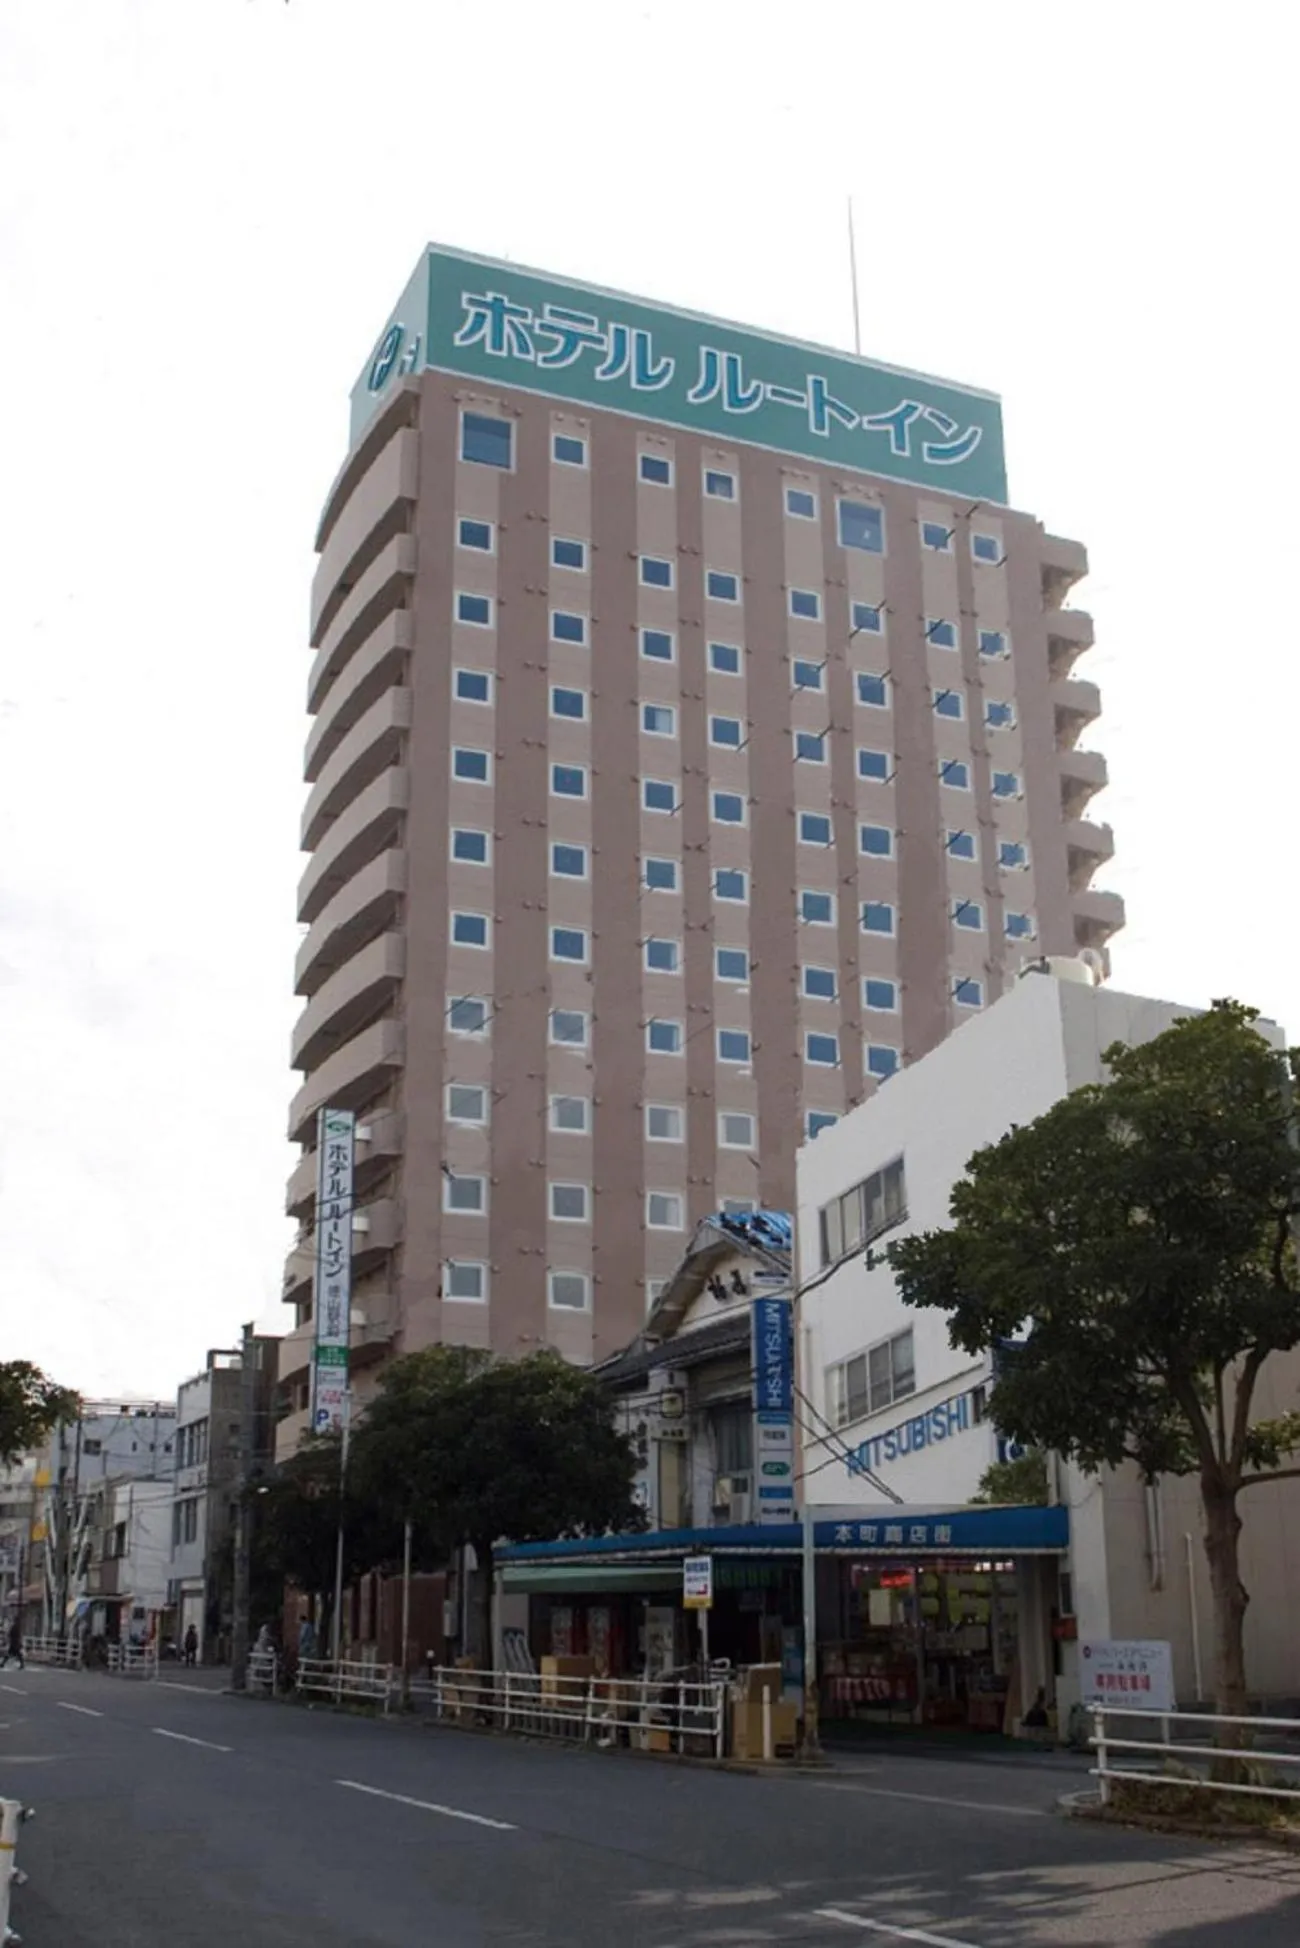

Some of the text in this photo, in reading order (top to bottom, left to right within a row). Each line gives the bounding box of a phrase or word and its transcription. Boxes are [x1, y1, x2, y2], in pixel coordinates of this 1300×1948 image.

[454, 289, 675, 392] ホテル
[688, 345, 983, 466] ルートイン
[328, 1144, 347, 1196] ホテル
[325, 1203, 345, 1278] ルートイン
[316, 1408, 329, 1425] P
[848, 1395, 968, 1478] MITSUBISHI
